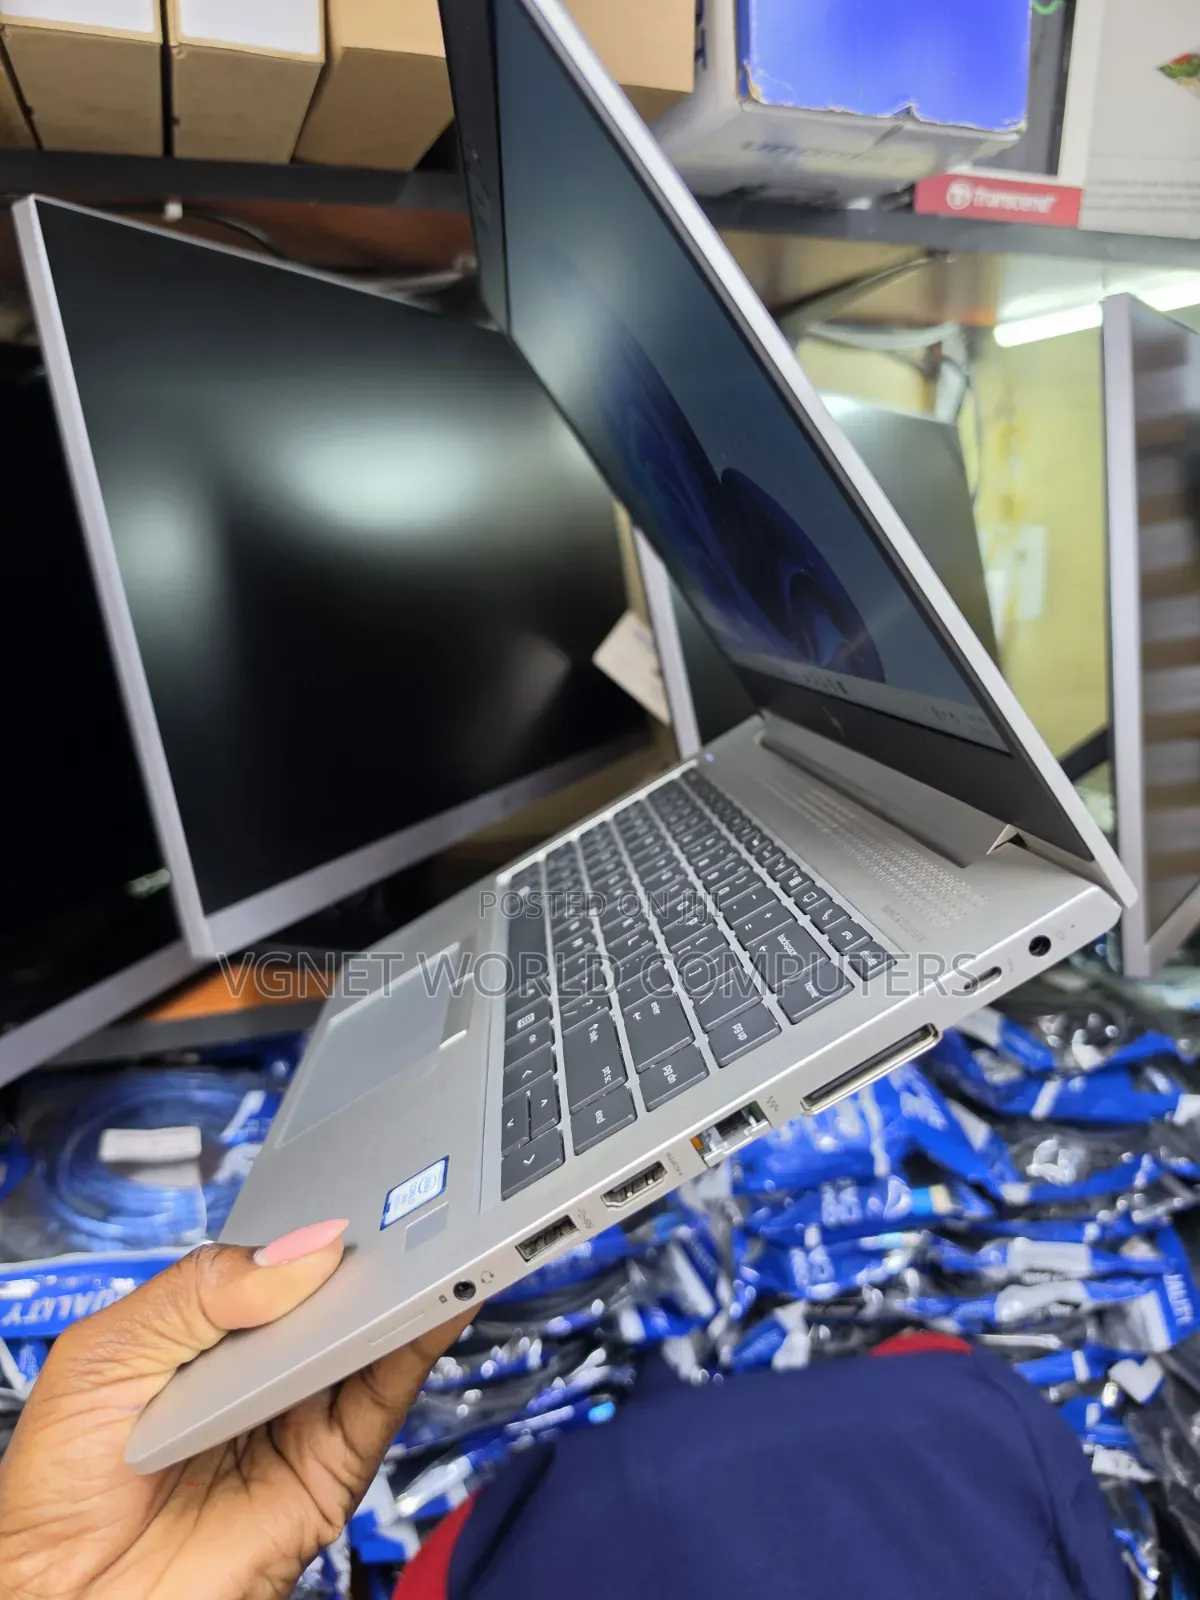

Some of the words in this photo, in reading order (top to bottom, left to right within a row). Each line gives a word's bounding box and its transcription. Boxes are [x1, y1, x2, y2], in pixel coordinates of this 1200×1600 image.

[777, 932, 798, 957] backspace
[803, 980, 820, 999] home
[650, 1001, 661, 1015] enter
[594, 1109, 606, 1125] end
[1, 1286, 124, 1326] UALITY
